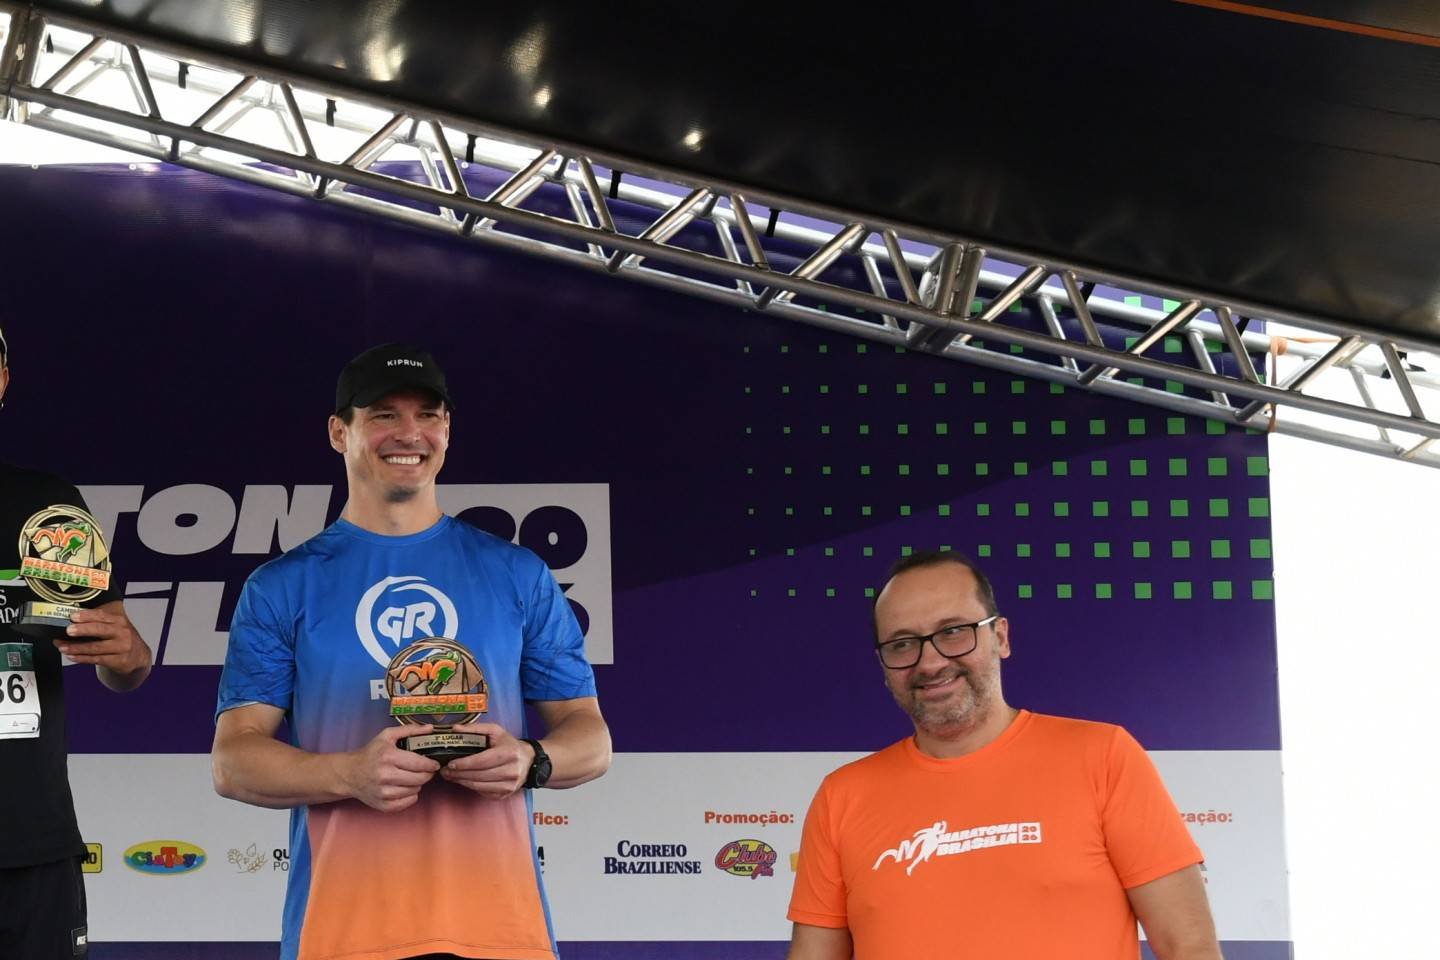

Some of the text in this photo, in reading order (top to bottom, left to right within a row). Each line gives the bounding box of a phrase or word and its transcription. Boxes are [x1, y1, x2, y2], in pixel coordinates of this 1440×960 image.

[387, 358, 423, 368] KIPRUN
[376, 601, 437, 648] GR
[704, 811, 794, 828] Promoção:
[938, 823, 1018, 843] MARATONA
[617, 840, 687, 857] CORREIO
[604, 857, 702, 874] BRAZILIENSE
